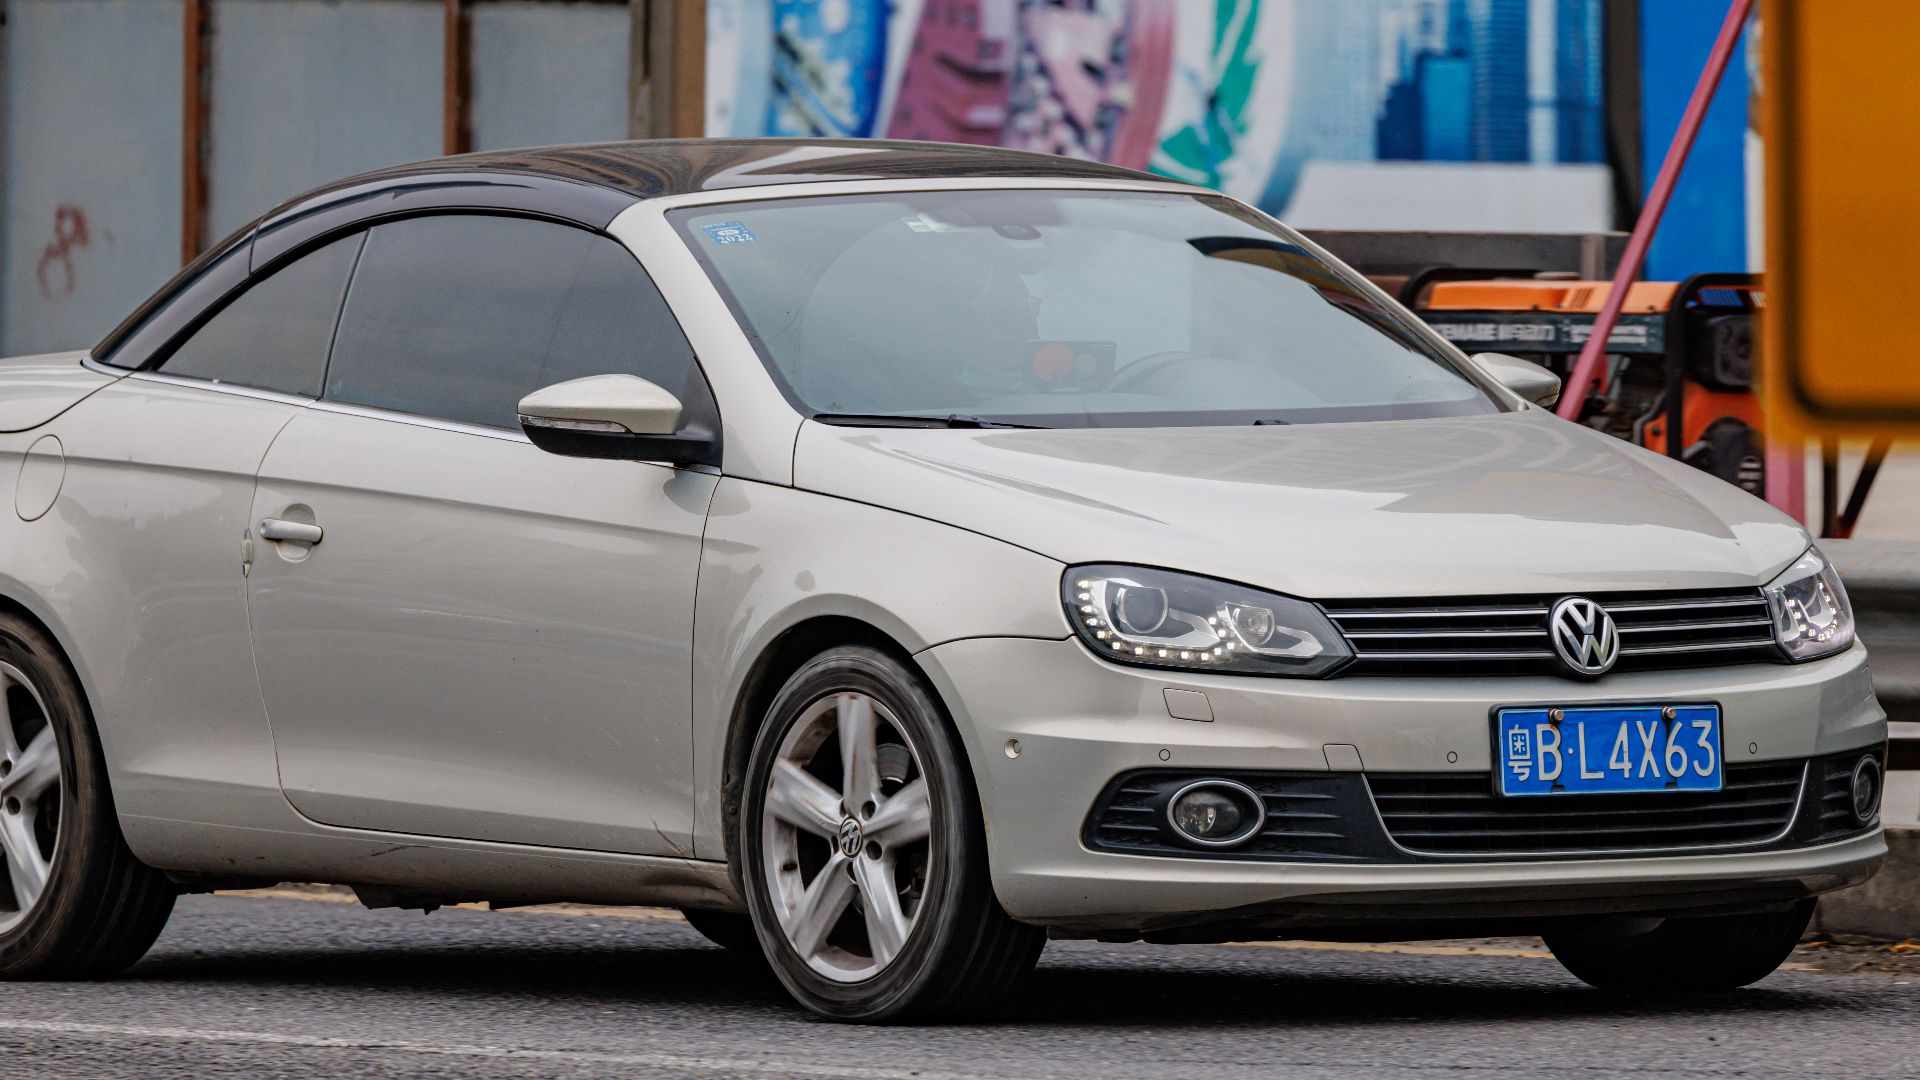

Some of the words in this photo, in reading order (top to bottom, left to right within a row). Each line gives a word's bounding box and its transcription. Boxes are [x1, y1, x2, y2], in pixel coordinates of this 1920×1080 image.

[717, 233, 753, 244] 2022
[1555, 599, 1616, 670] VW
[1508, 721, 1715, 781] 粤B·L4X63
